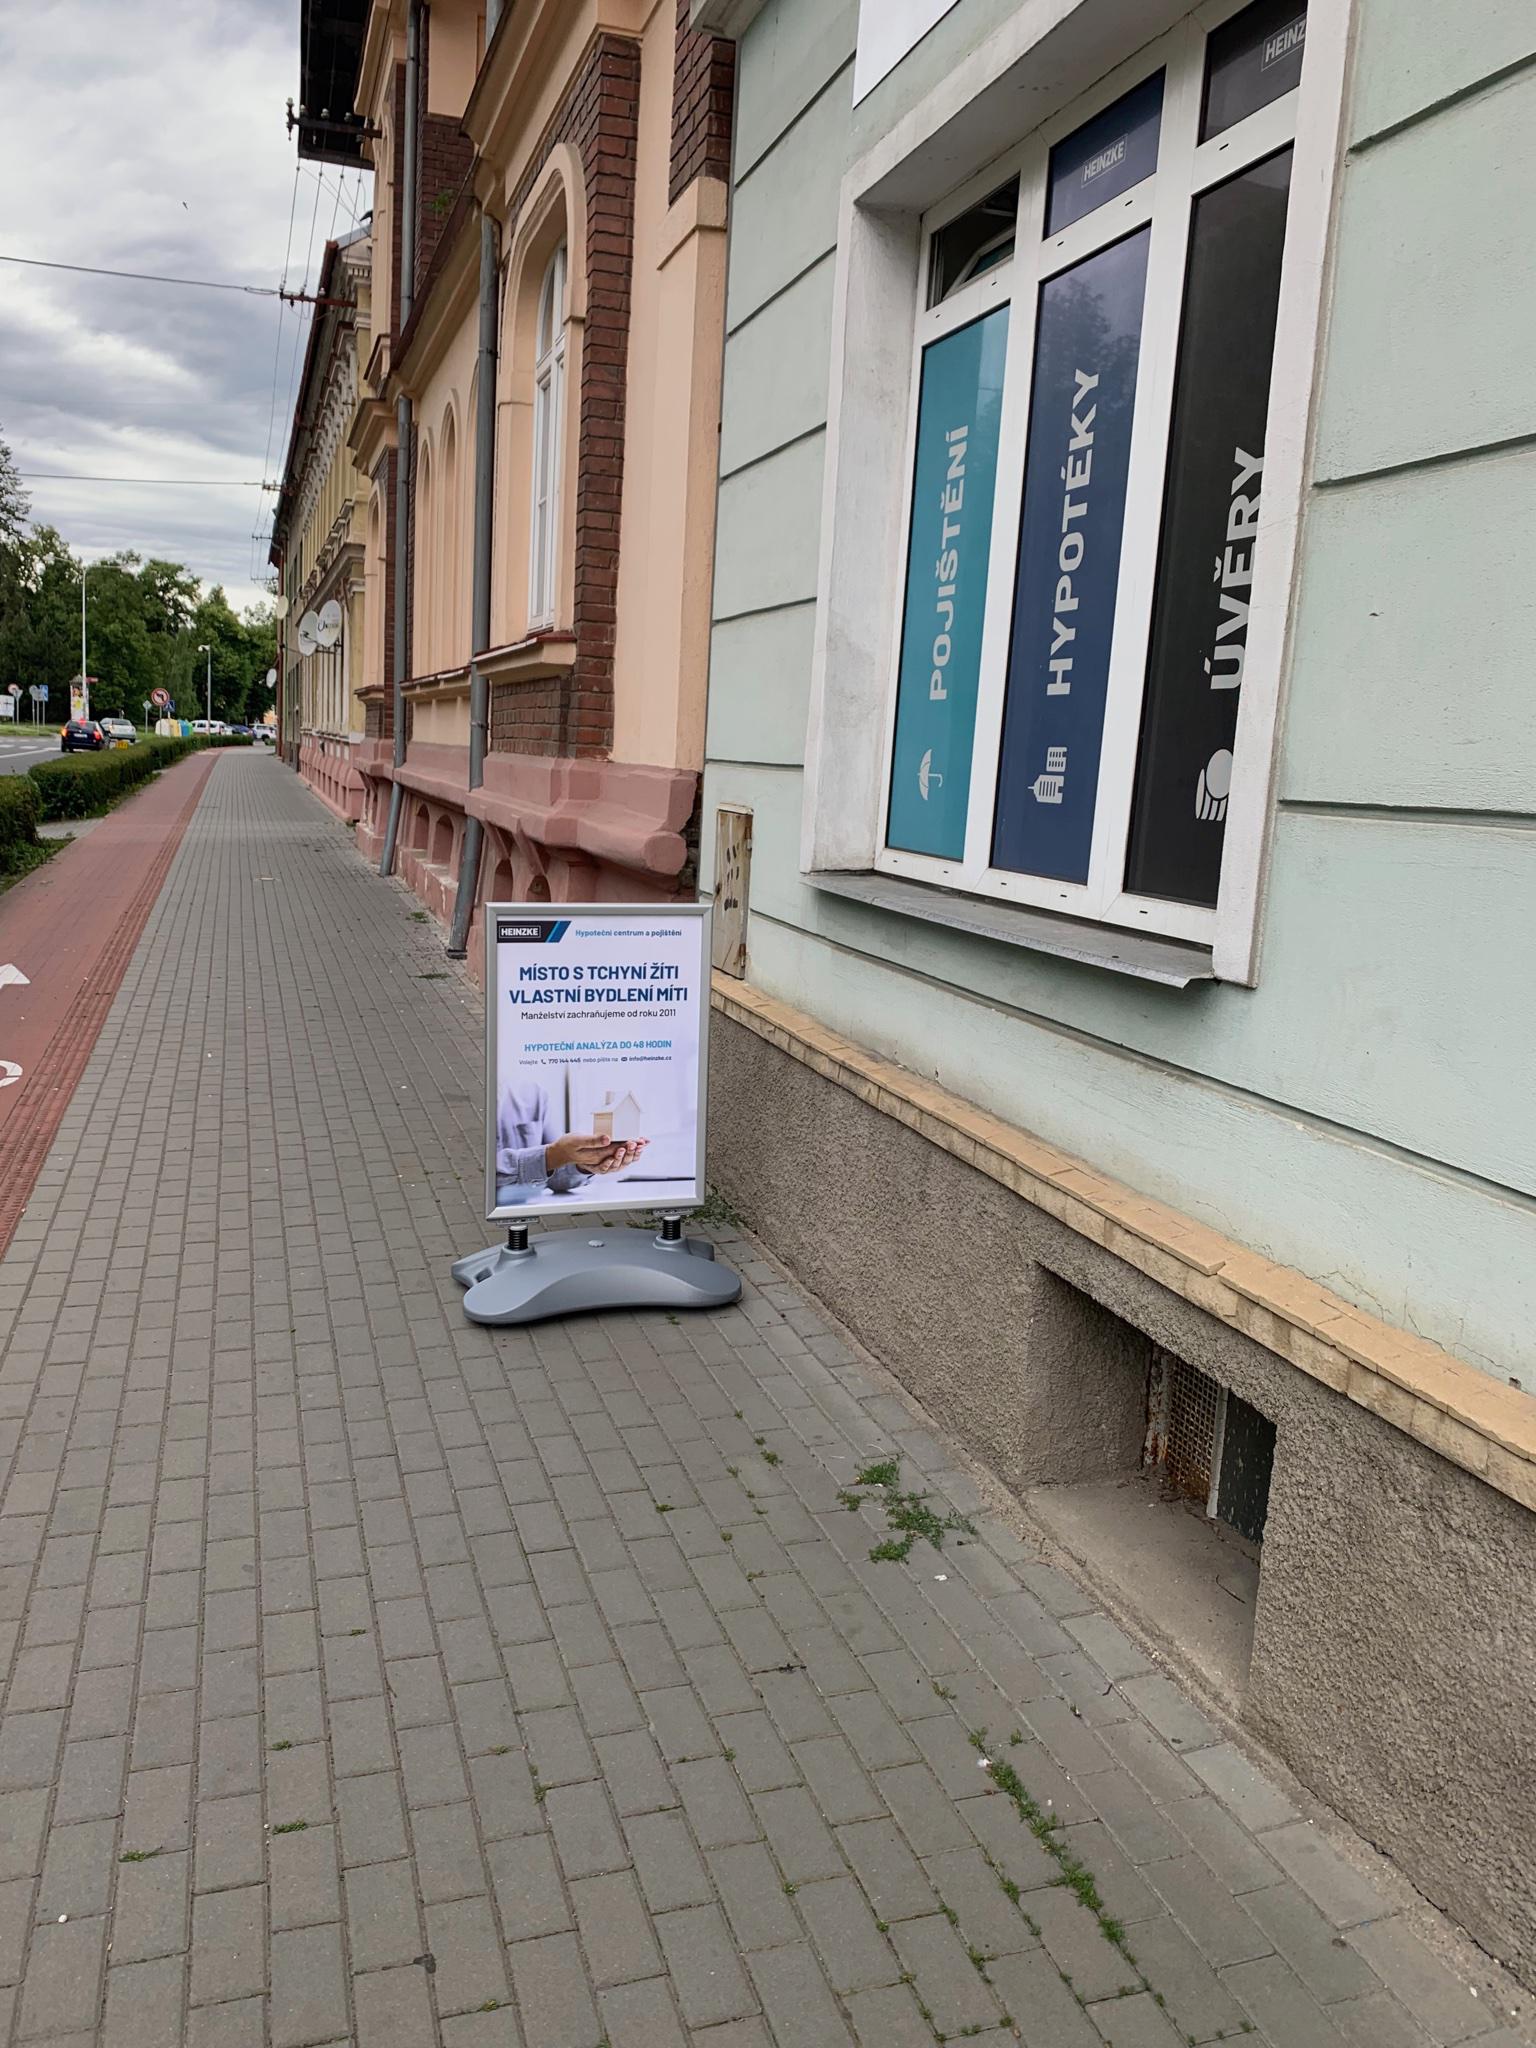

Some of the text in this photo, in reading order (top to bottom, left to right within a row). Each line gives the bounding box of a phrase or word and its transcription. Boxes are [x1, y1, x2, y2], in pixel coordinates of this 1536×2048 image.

[1083, 141, 1125, 181] HEINZKE
[1046, 368, 1100, 696] HYPOTÉKY
[929, 424, 969, 700] POJIŠTĚNÍ
[1203, 446, 1265, 690] ÚVĚRY
[501, 927, 538, 936] HEINZKE
[575, 929, 613, 938] Hypoteční
[651, 929, 682, 938] pojištění
[519, 962, 679, 981] MÍSTO S TCHYNÍ ŽÍTI
[509, 984, 688, 1004] VLASTNÍ BYDLENÍ MÍTI
[521, 1008, 676, 1020] Manželství zachraňujeme od roku 2011
[524, 1039, 672, 1052] HYPOTEČNÍ ANALÝZA DO 48 HODIN
